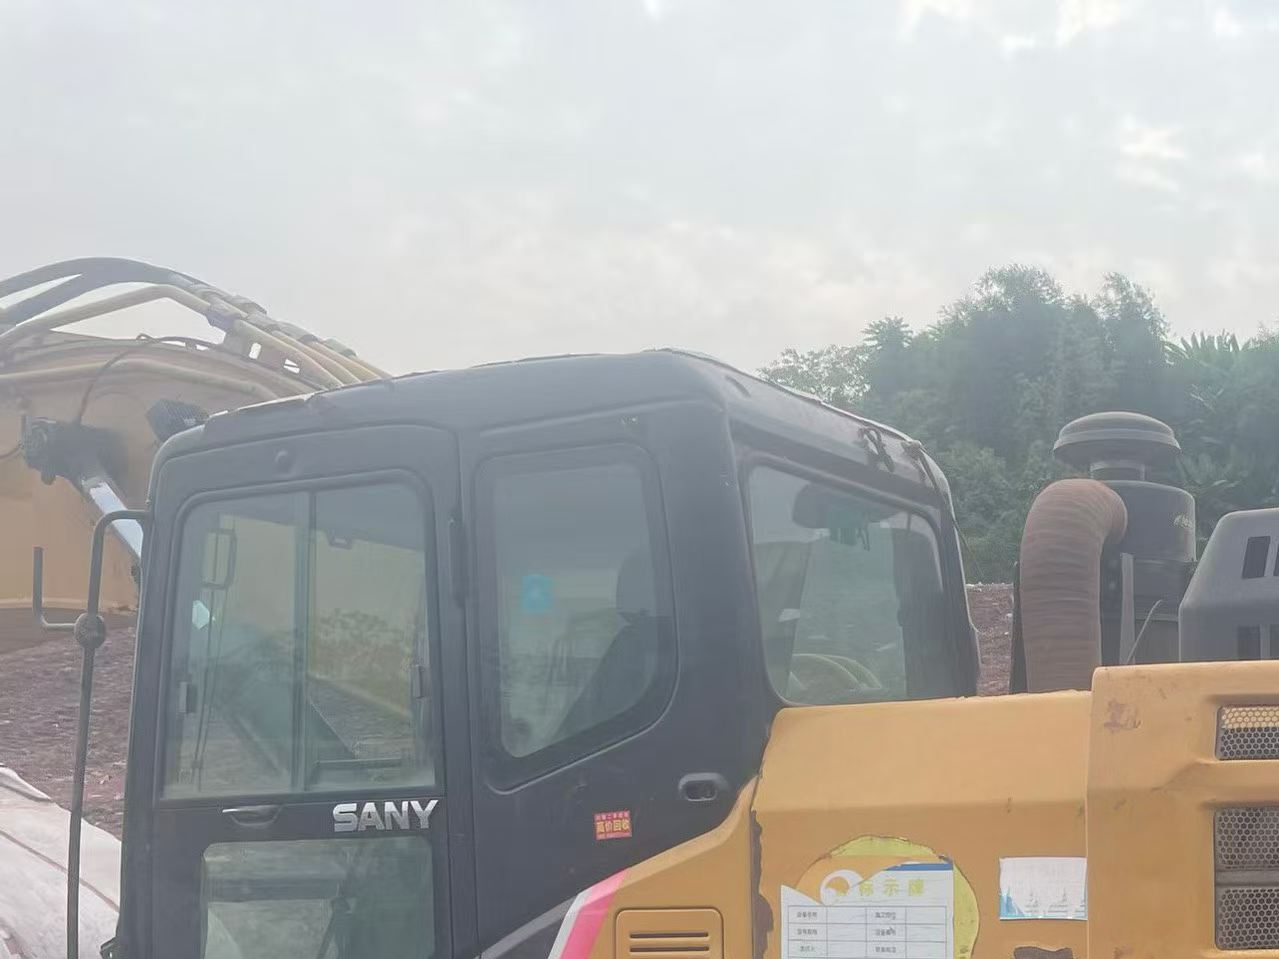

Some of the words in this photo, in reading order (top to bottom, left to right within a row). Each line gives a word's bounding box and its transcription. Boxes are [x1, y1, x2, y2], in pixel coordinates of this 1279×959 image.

[332, 799, 438, 832] SANY
[596, 818, 630, 833] 高价回收
